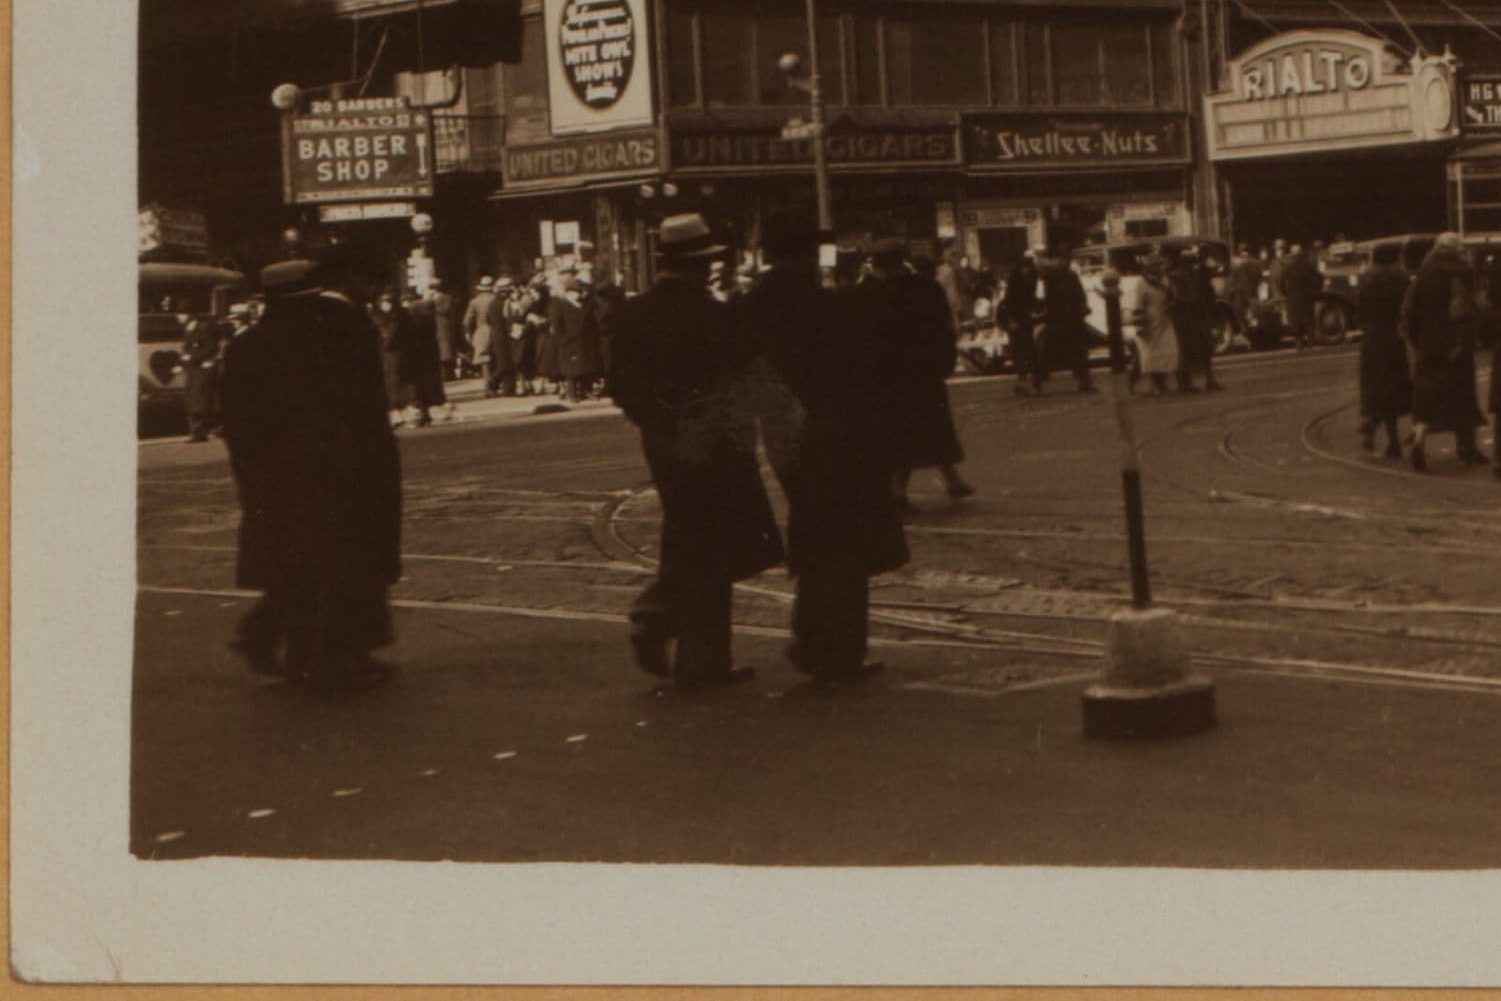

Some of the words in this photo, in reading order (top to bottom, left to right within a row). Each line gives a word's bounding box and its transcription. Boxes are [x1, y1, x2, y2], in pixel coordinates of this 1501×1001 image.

[1243, 50, 1371, 100] RIALTO
[311, 101, 332, 114] 20
[337, 97, 405, 112] BARBERS
[299, 134, 407, 160] BARBER
[506, 147, 580, 179] UNITED
[582, 138, 655, 170] CIGARS
[316, 159, 389, 182] SHOP
